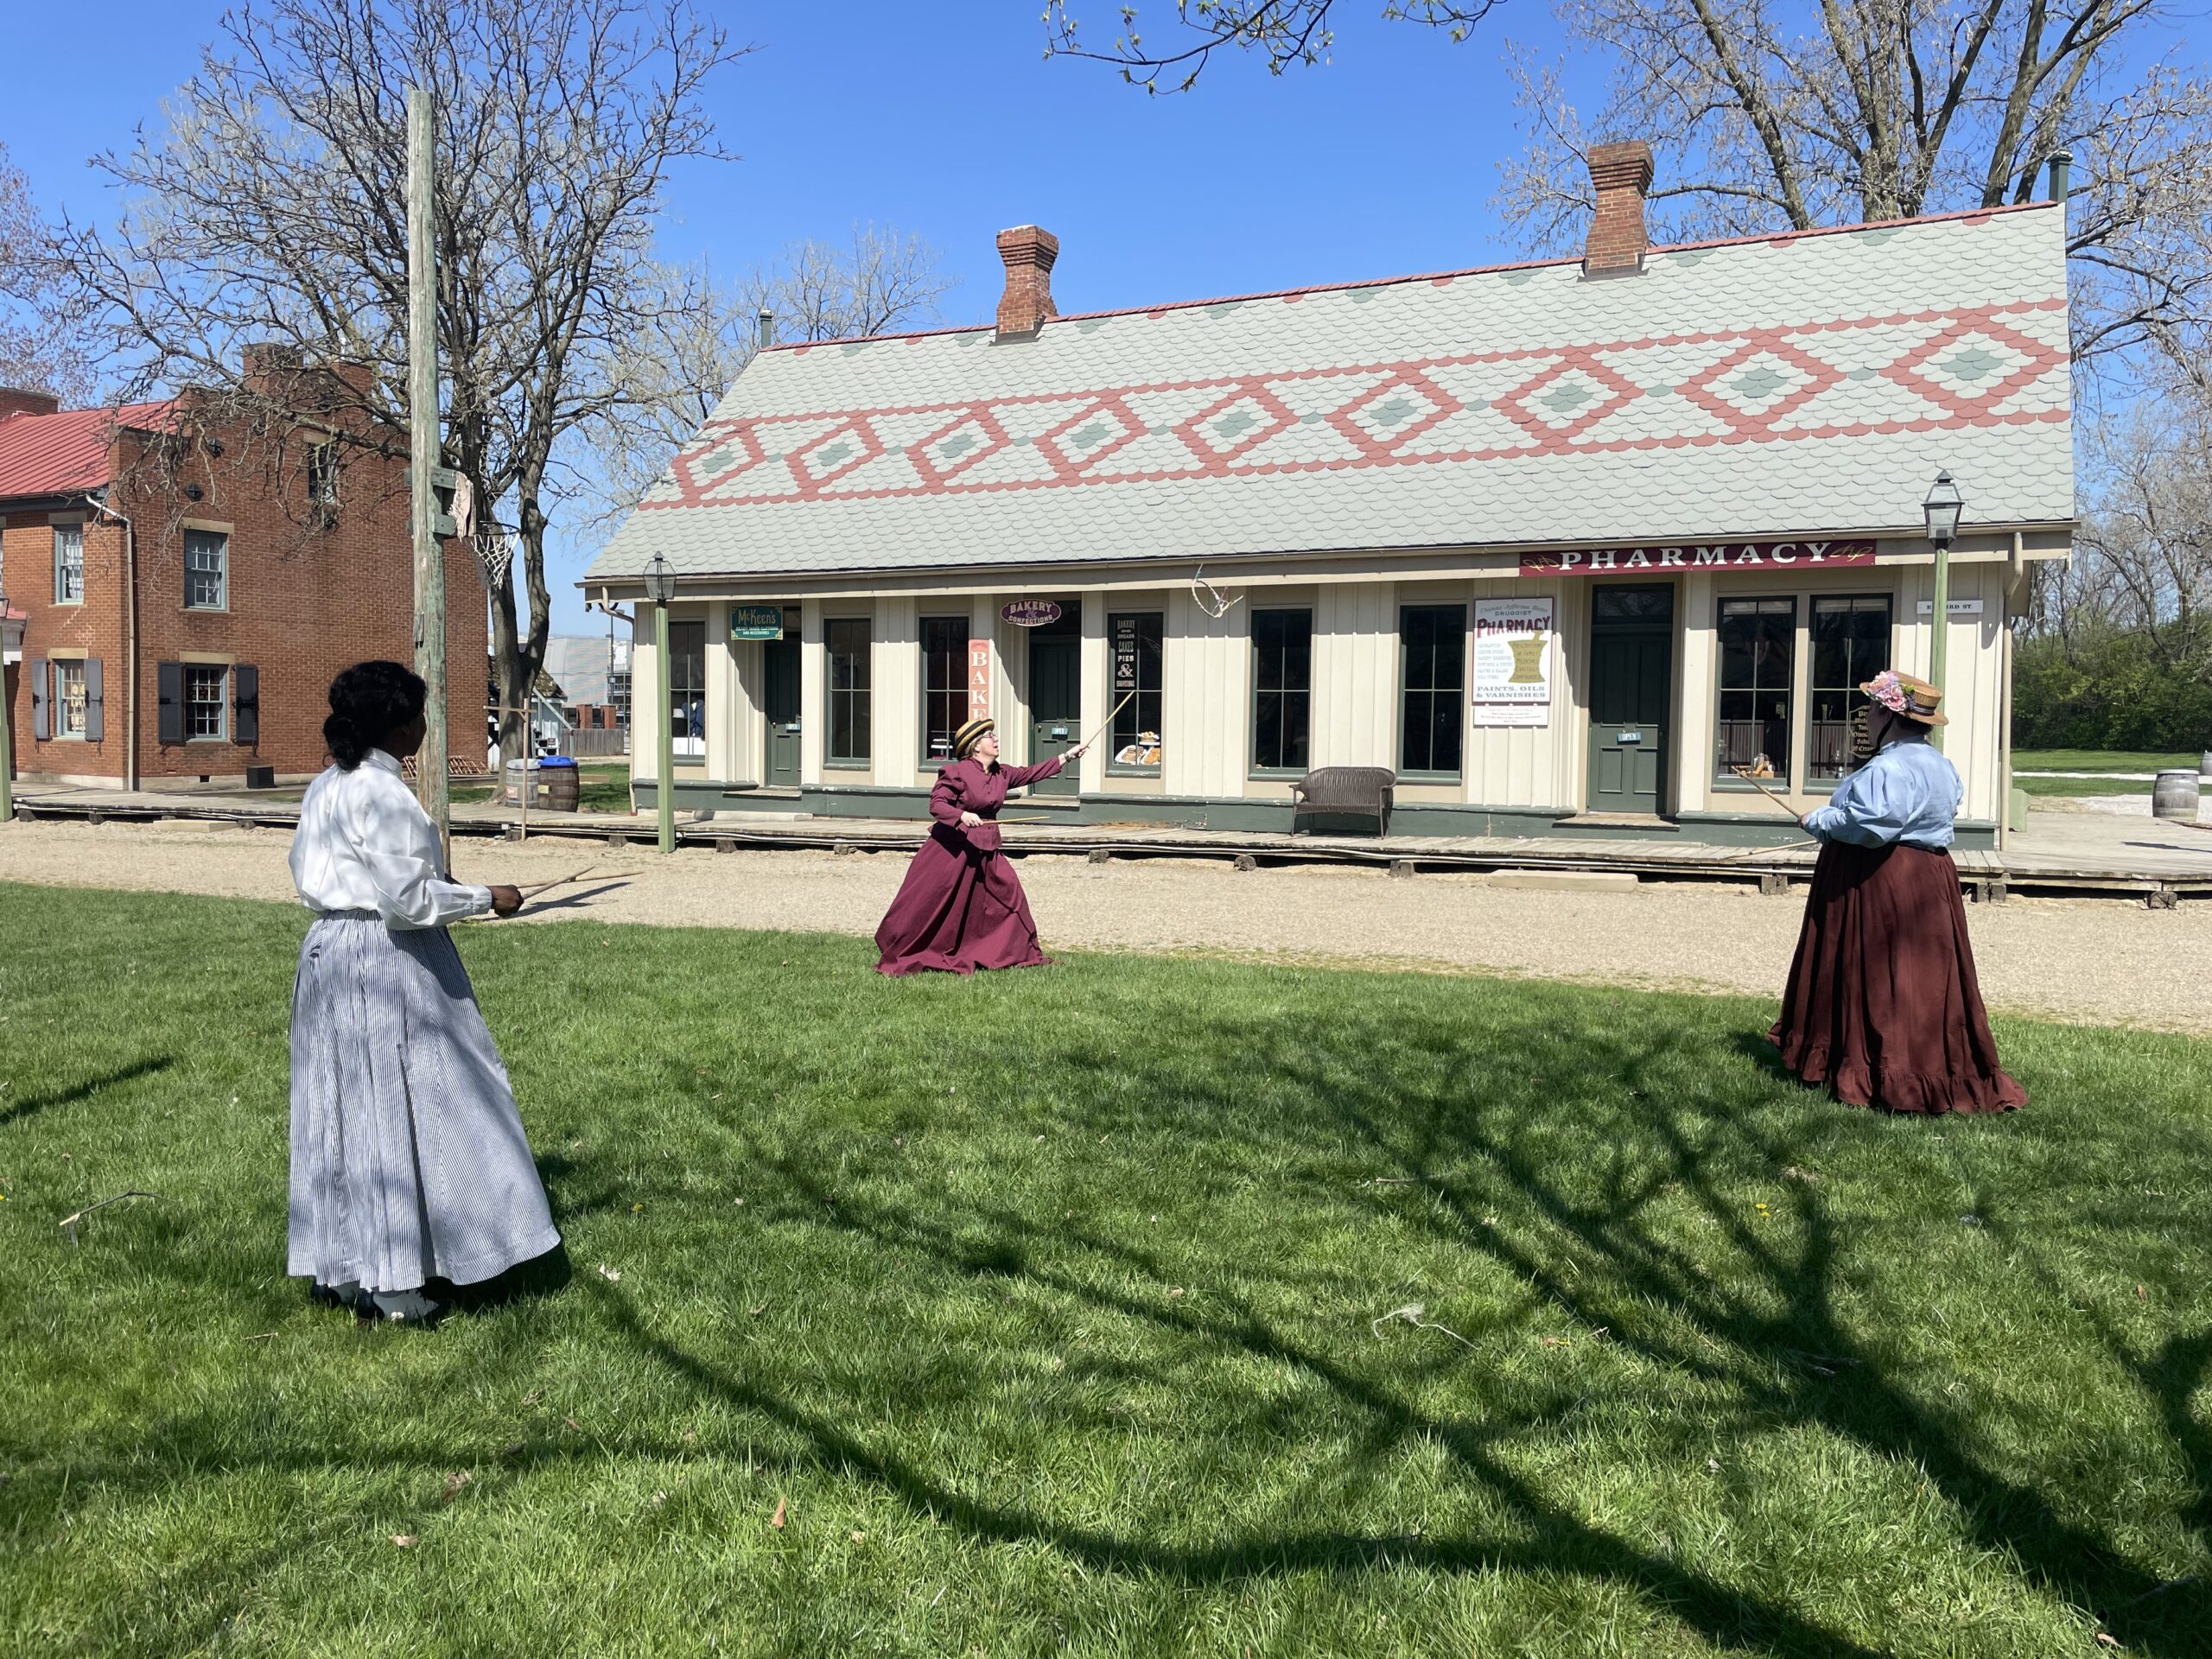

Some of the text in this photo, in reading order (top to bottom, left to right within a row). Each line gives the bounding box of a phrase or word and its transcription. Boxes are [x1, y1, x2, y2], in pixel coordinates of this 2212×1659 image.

[1559, 542, 1832, 570] PHARMACY
[1010, 601, 1052, 613] BAKERY
[738, 608, 776, 626] McKeen's
[1008, 614, 1052, 625] CONFECTIONS
[1478, 616, 1550, 639] PHARMACY
[1119, 641, 1134, 652] CAKES
[1117, 663, 1134, 677] &
[971, 652, 988, 720] BAKE
